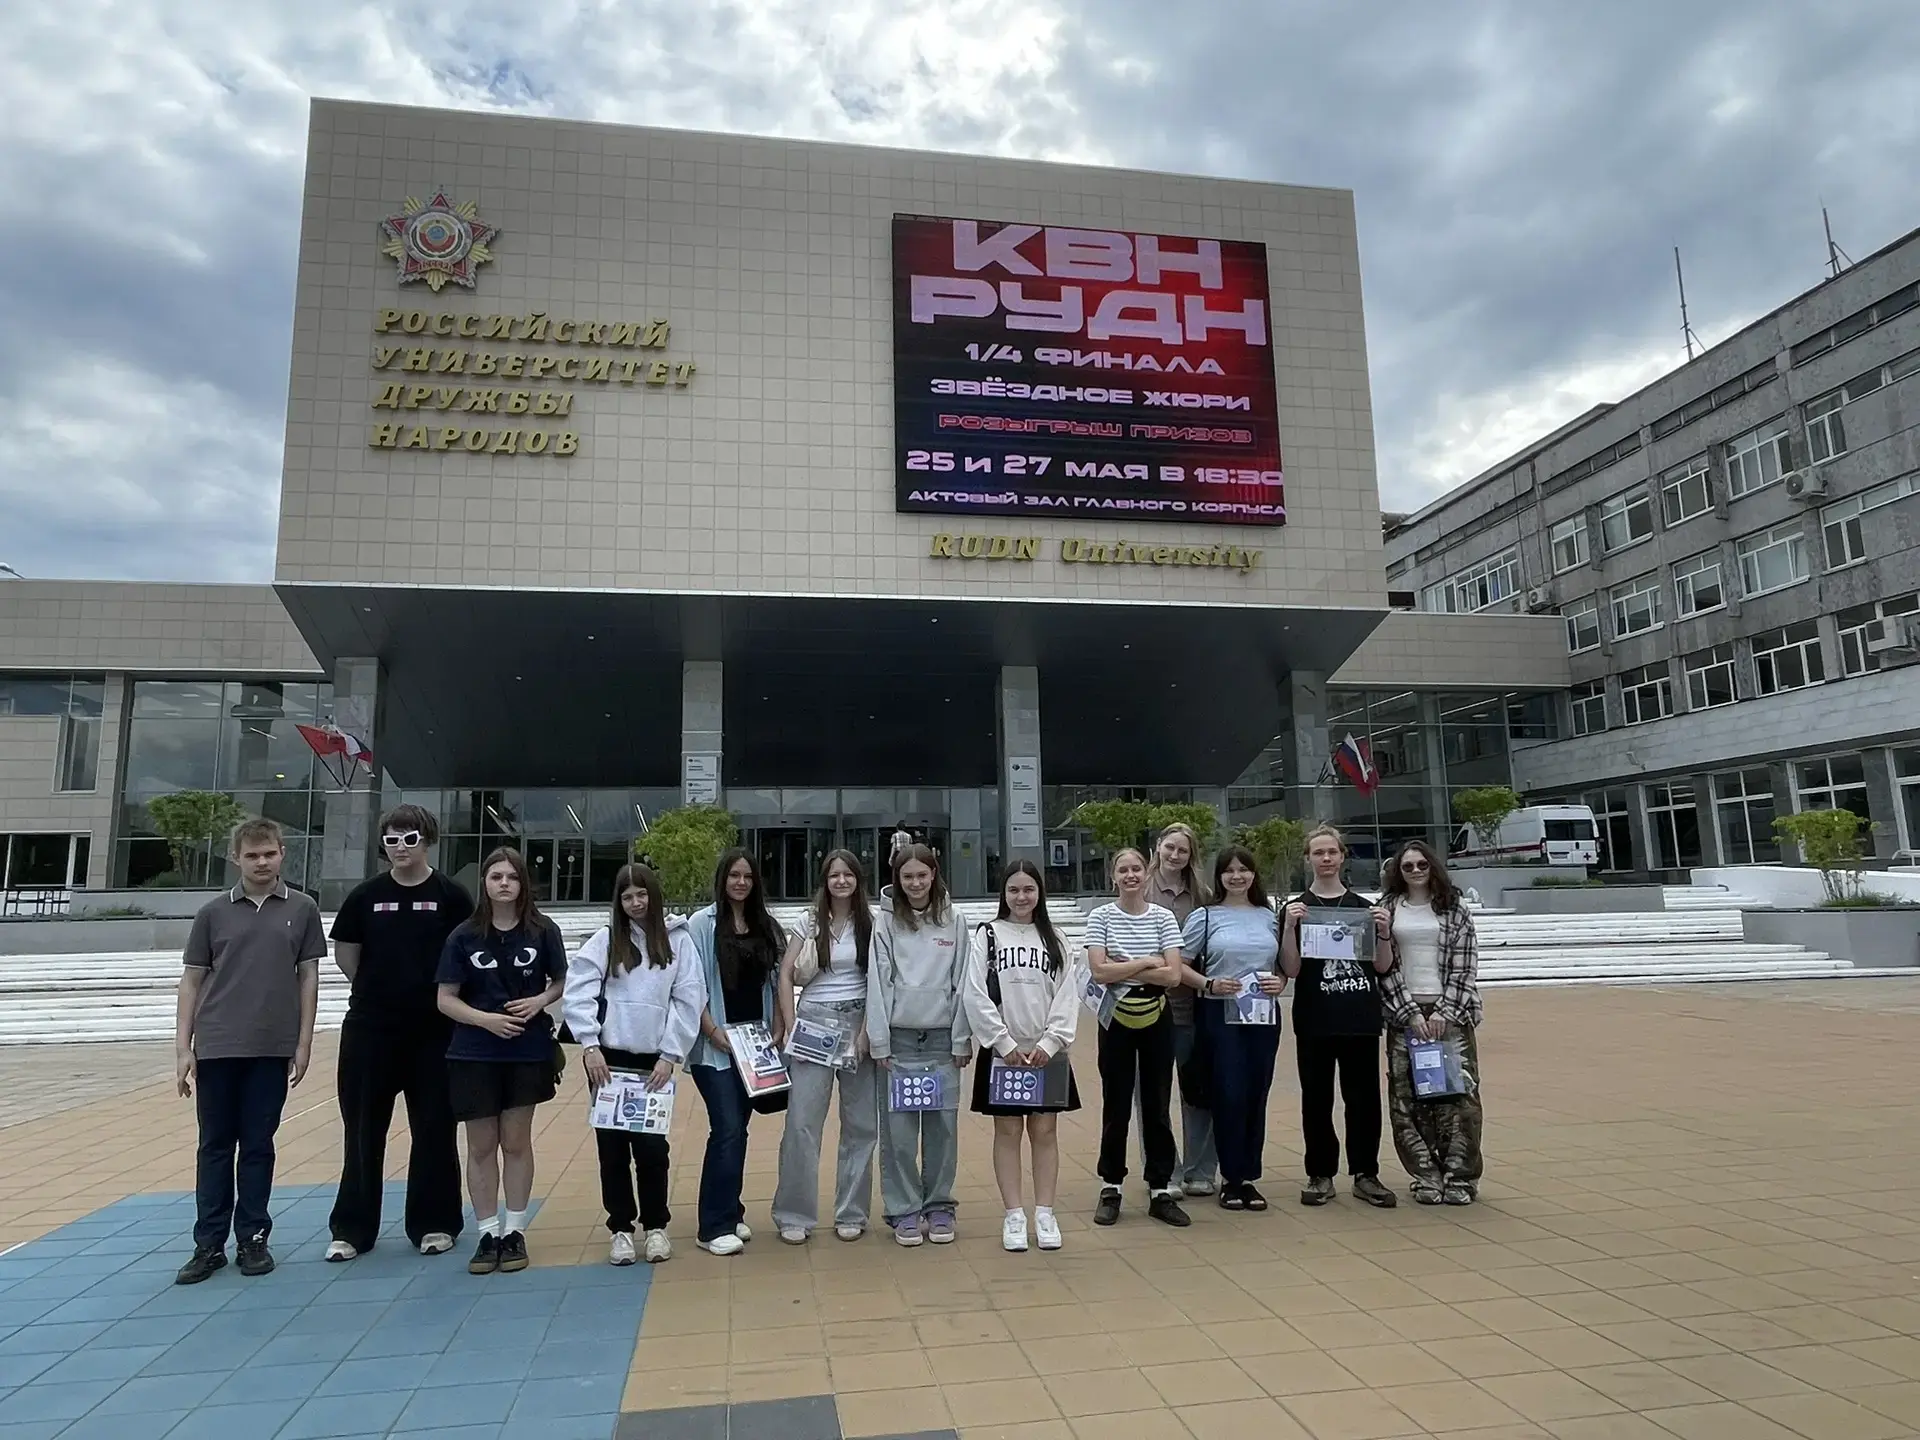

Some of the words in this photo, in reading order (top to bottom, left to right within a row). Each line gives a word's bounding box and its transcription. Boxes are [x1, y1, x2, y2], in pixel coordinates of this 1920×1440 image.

[953, 219, 1224, 290] КВН
[374, 307, 671, 349] РОССИЙСКИЙ
[910, 274, 1267, 346] РУДН
[372, 346, 697, 388] УНИВЕРСИТЕТ
[964, 343, 1022, 364] 1/4
[1034, 347, 1225, 375] ФИНАЛА
[371, 384, 574, 416] ДРУЖБЫ
[930, 376, 1133, 404] ЗВЁЗДНОЕ
[1143, 390, 1251, 411] ЖЮРИ
[368, 423, 580, 456] НАРОДОВ
[938, 414, 1123, 438] РОЗЫГРЫШ
[1130, 424, 1253, 444] ПРИЗОВ
[906, 450, 956, 472] 25
[964, 456, 992, 474] И
[1003, 454, 1052, 476] 27
[1065, 461, 1148, 480] МАЯ
[1159, 465, 1185, 482] В
[1193, 467, 1284, 486] 18:30
[907, 490, 1019, 505] АКТОВЫЙ
[1024, 496, 1070, 507] ЗАЛ
[1074, 497, 1187, 511] ГЛАВНОГО
[1192, 502, 1287, 515] КОРПУСА
[930, 532, 1042, 561] RUDN
[1062, 538, 1264, 577] University
[998, 946, 1057, 982] HICAG
